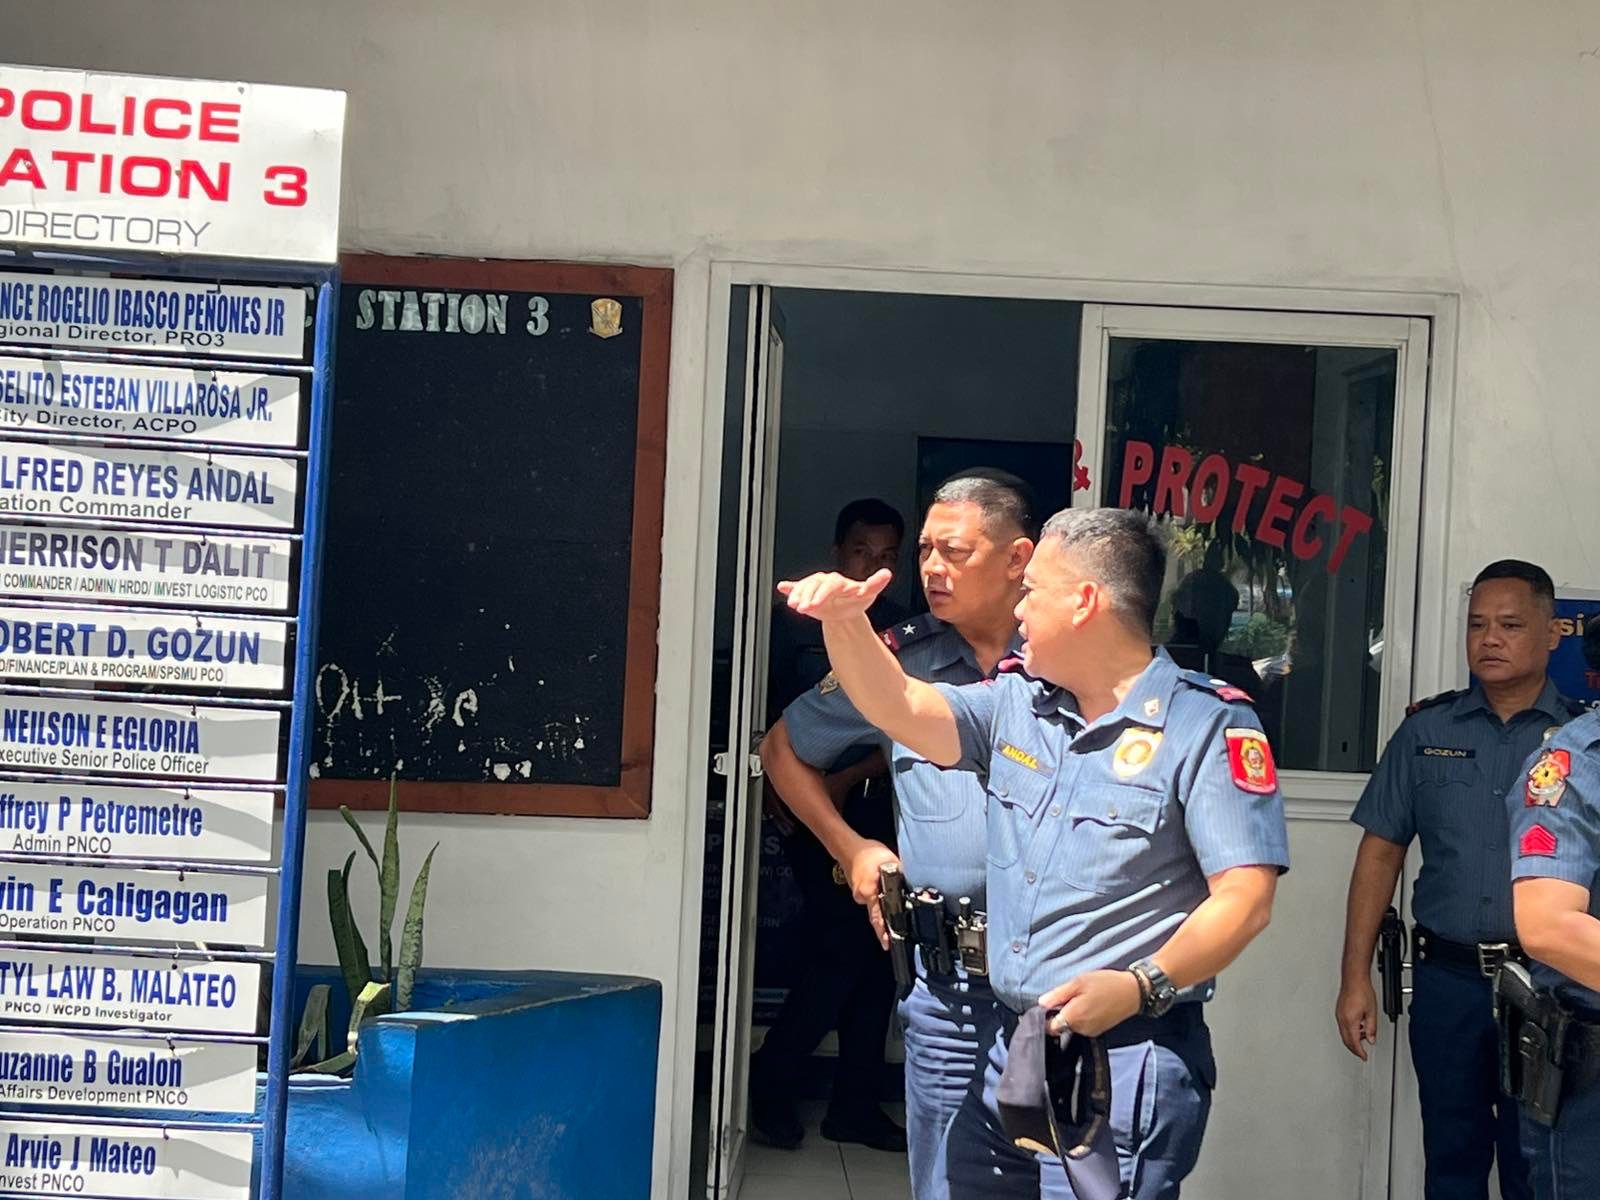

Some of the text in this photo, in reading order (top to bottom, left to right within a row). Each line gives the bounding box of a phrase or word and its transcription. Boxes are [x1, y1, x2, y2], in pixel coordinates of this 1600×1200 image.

[263, 165, 308, 207] 3
[38, 285, 107, 325] ROGELIO
[114, 290, 179, 329] IBASCO
[184, 290, 261, 334] PEÑONES
[266, 298, 284, 336] JR
[356, 289, 509, 334] STATION
[527, 296, 549, 336] 3
[68, 326, 156, 346] Director,
[166, 332, 224, 347] PRO3
[61, 375, 139, 411] ESTEBAN
[146, 379, 241, 418] VILLAROSA
[246, 387, 272, 421] JR.
[37, 410, 126, 431] Director,
[133, 418, 197, 434] ACPO
[1, 456, 274, 504] LFRED REYES ANDAL
[59, 497, 191, 519] Commander
[1119, 440, 1373, 574] PROTECT
[155, 540, 172, 572] T
[183, 542, 270, 578] DALIT
[4, 574, 72, 591] COMMANDER
[195, 586, 242, 600] LOGISTIC
[246, 588, 268, 601] PCO
[107, 626, 134, 659] D.
[147, 628, 260, 664] GOZUN
[91, 664, 98, 676] &
[102, 664, 197, 680] PROGRAM/SPSMU
[201, 669, 223, 681] PCO
[4, 709, 199, 754] NEILSON E EGLORIA
[61, 749, 108, 768] Senior
[113, 752, 156, 771] Police
[161, 755, 208, 774] Officer
[59, 796, 71, 830] P
[81, 798, 203, 837] Petremetre
[13, 834, 111, 854] Admin PNCO
[49, 878, 62, 913] E
[78, 879, 228, 924] Caligagan
[72, 918, 115, 932] PNCO
[48, 964, 96, 1001] LAW
[102, 968, 121, 1002] B.
[131, 969, 236, 1008] MALATEO
[5, 1001, 41, 1014] PNCO
[52, 1004, 91, 1017] WCPD
[95, 1008, 172, 1022] Investigator
[84, 1050, 95, 1083] B
[108, 1051, 181, 1088] Gualon
[48, 1086, 141, 1104] Development
[146, 1091, 188, 1105] PNCO
[6, 1133, 156, 1175] Arvie J Mateo
[41, 1175, 84, 1192] PNCO
